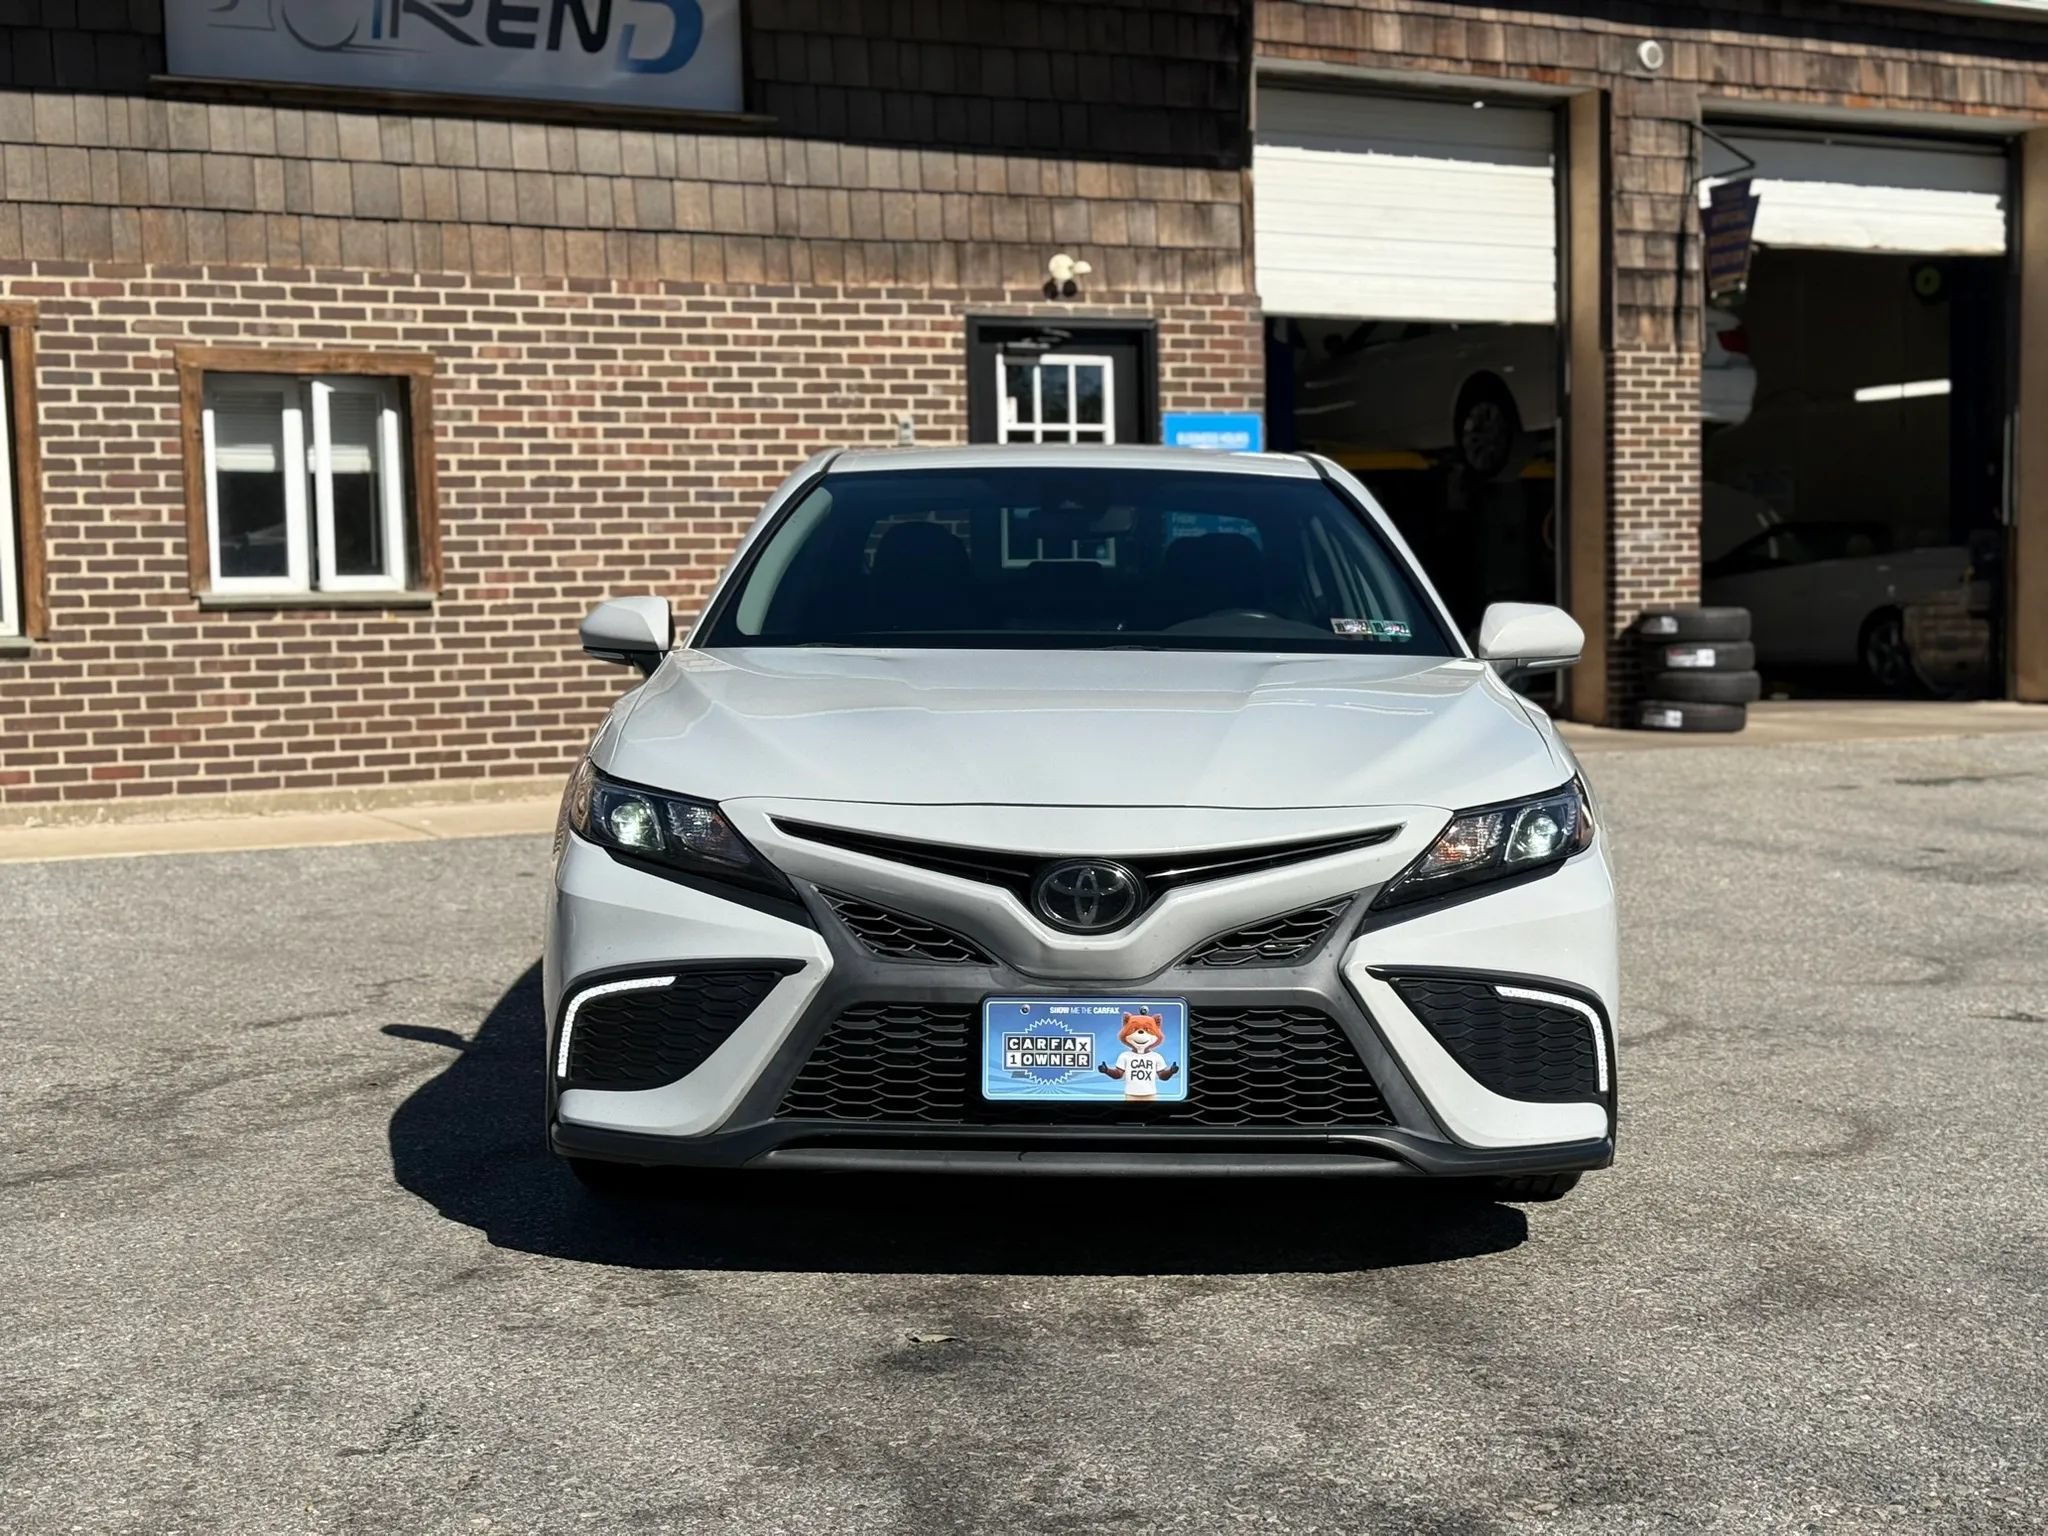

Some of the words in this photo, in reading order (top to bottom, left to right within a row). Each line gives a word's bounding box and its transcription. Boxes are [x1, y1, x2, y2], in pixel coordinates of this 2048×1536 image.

[1049, 1006, 1070, 1014] SHOW
[1070, 1006, 1080, 1015] ME
[1081, 1006, 1093, 1015] THE
[1093, 1006, 1120, 1015] CARFAX
[1008, 1037, 1089, 1052] CARFAX
[1130, 1058, 1153, 1069] CAR
[1130, 1070, 1152, 1081] FOX
